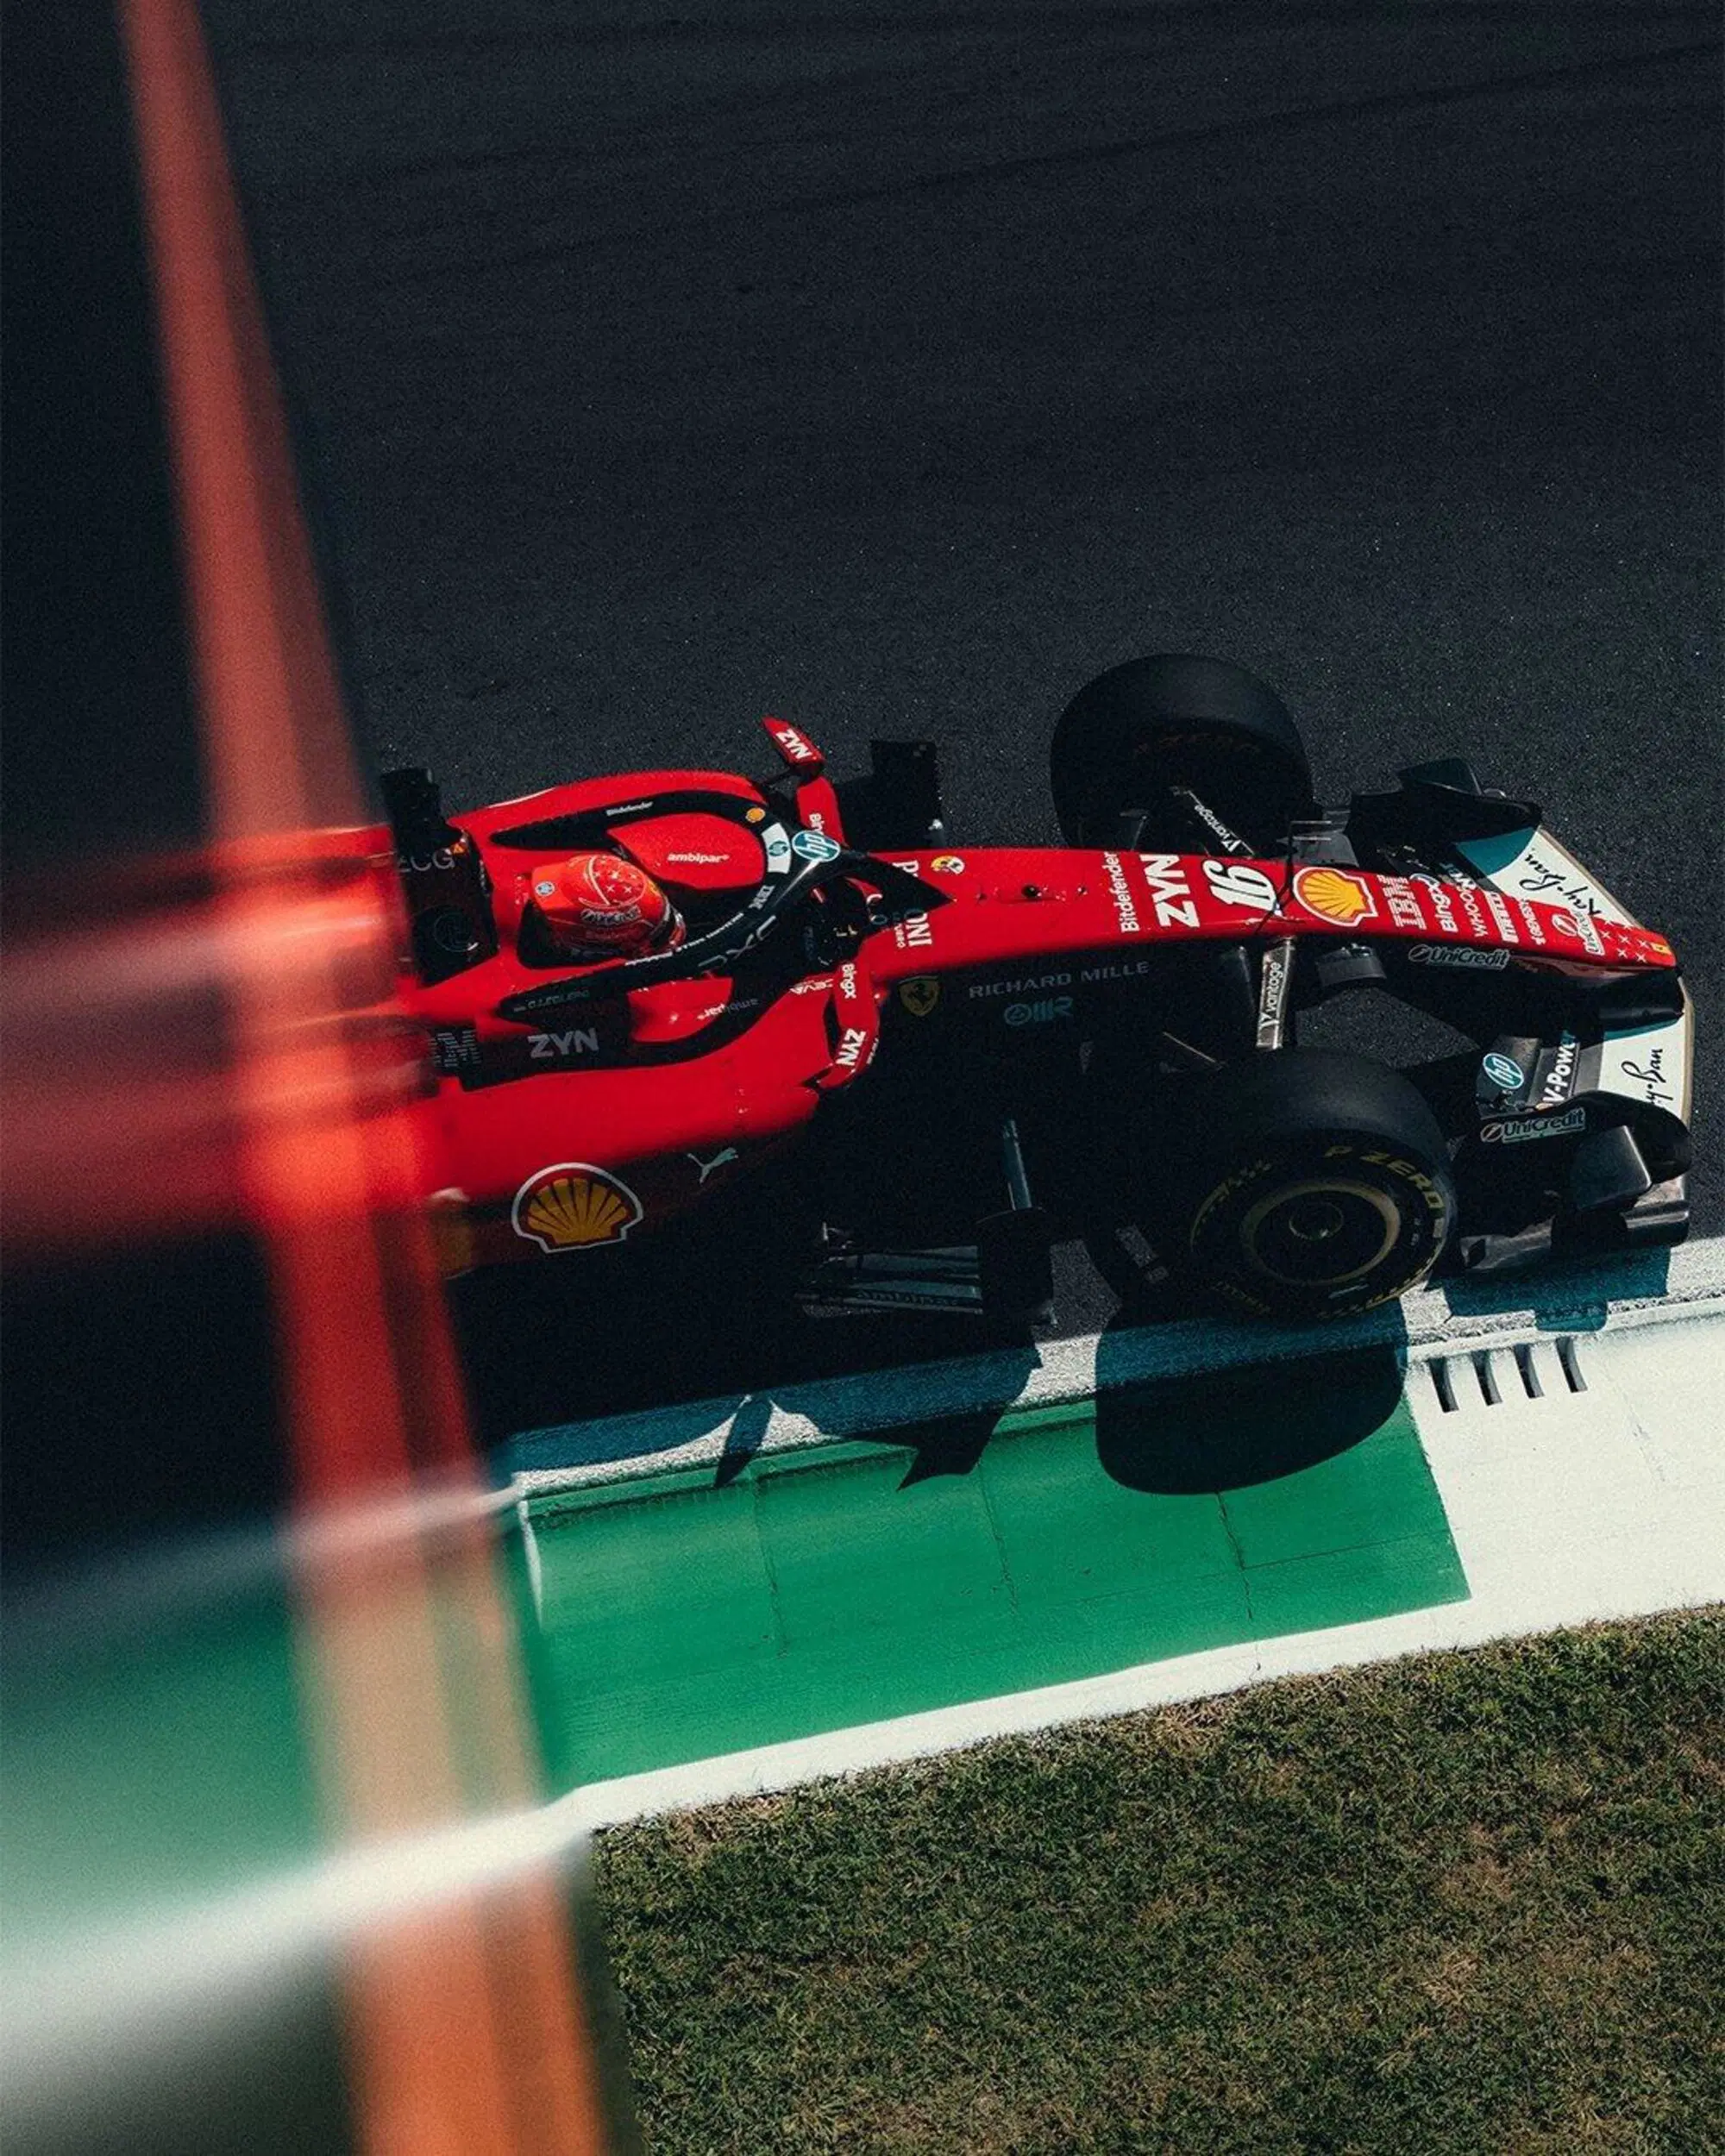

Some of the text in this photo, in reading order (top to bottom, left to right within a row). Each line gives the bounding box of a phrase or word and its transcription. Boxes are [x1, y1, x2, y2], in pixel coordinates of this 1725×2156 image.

[776, 729, 812, 759] ZYN
[892, 859, 933, 947] PONI
[1102, 851, 1140, 933] Bitdefender
[1139, 854, 1201, 928] ZYN
[1202, 860, 1279, 912] 16
[1428, 948, 1509, 968] UniCredit
[968, 961, 1150, 999] RICHARD MILLE
[527, 1027, 599, 1060] ZYN
[835, 1028, 867, 1067] ZYN
[1484, 1052, 1524, 1089] hp
[1359, 1150, 1445, 1208] ZERO
